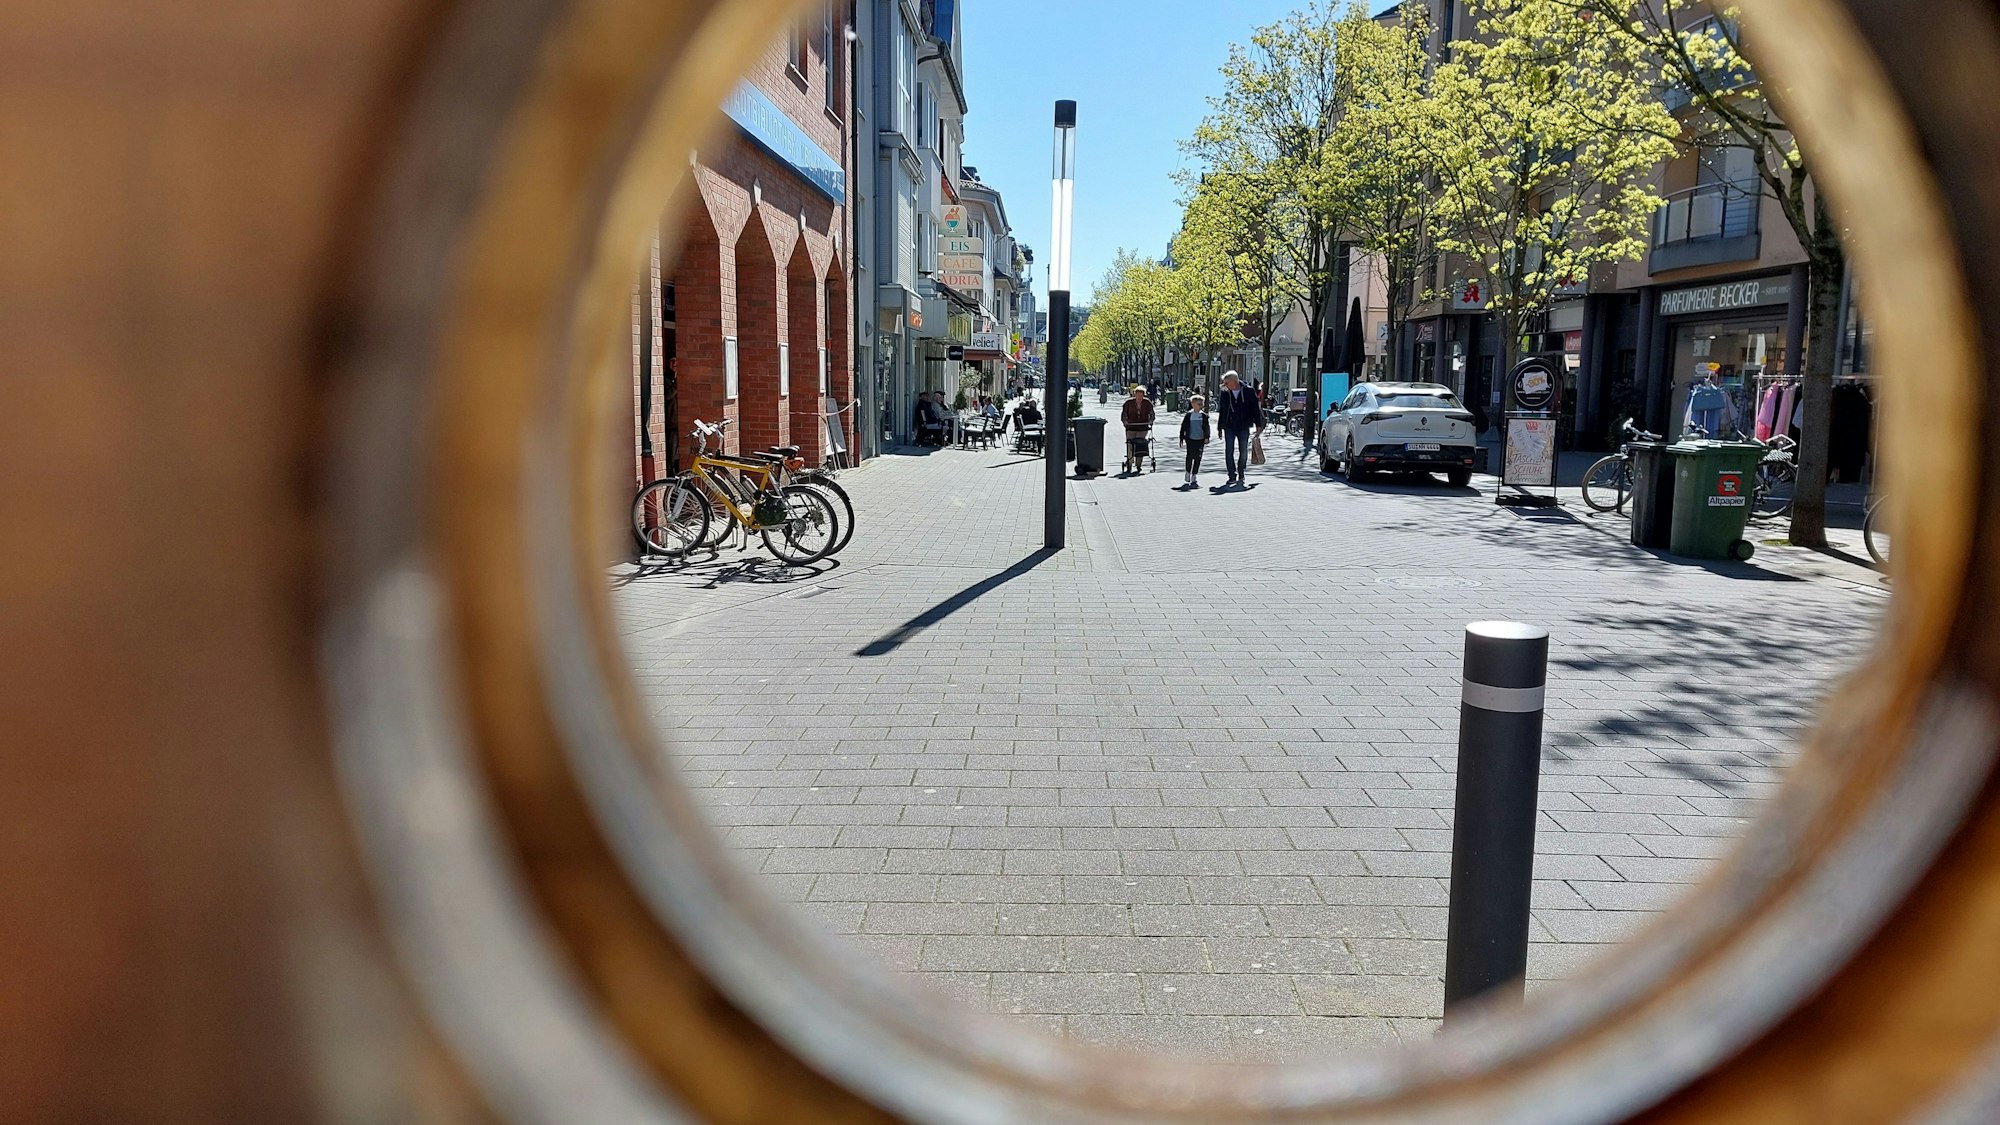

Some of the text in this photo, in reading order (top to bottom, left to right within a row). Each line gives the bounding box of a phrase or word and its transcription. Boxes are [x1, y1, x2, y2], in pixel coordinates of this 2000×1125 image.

[951, 241, 969, 251] EIS
[940, 273, 979, 285] ADRIA
[1719, 281, 1760, 308] BECKER
[1512, 464, 1545, 475] SCHUHE
[1710, 496, 1744, 506] Altpapier
